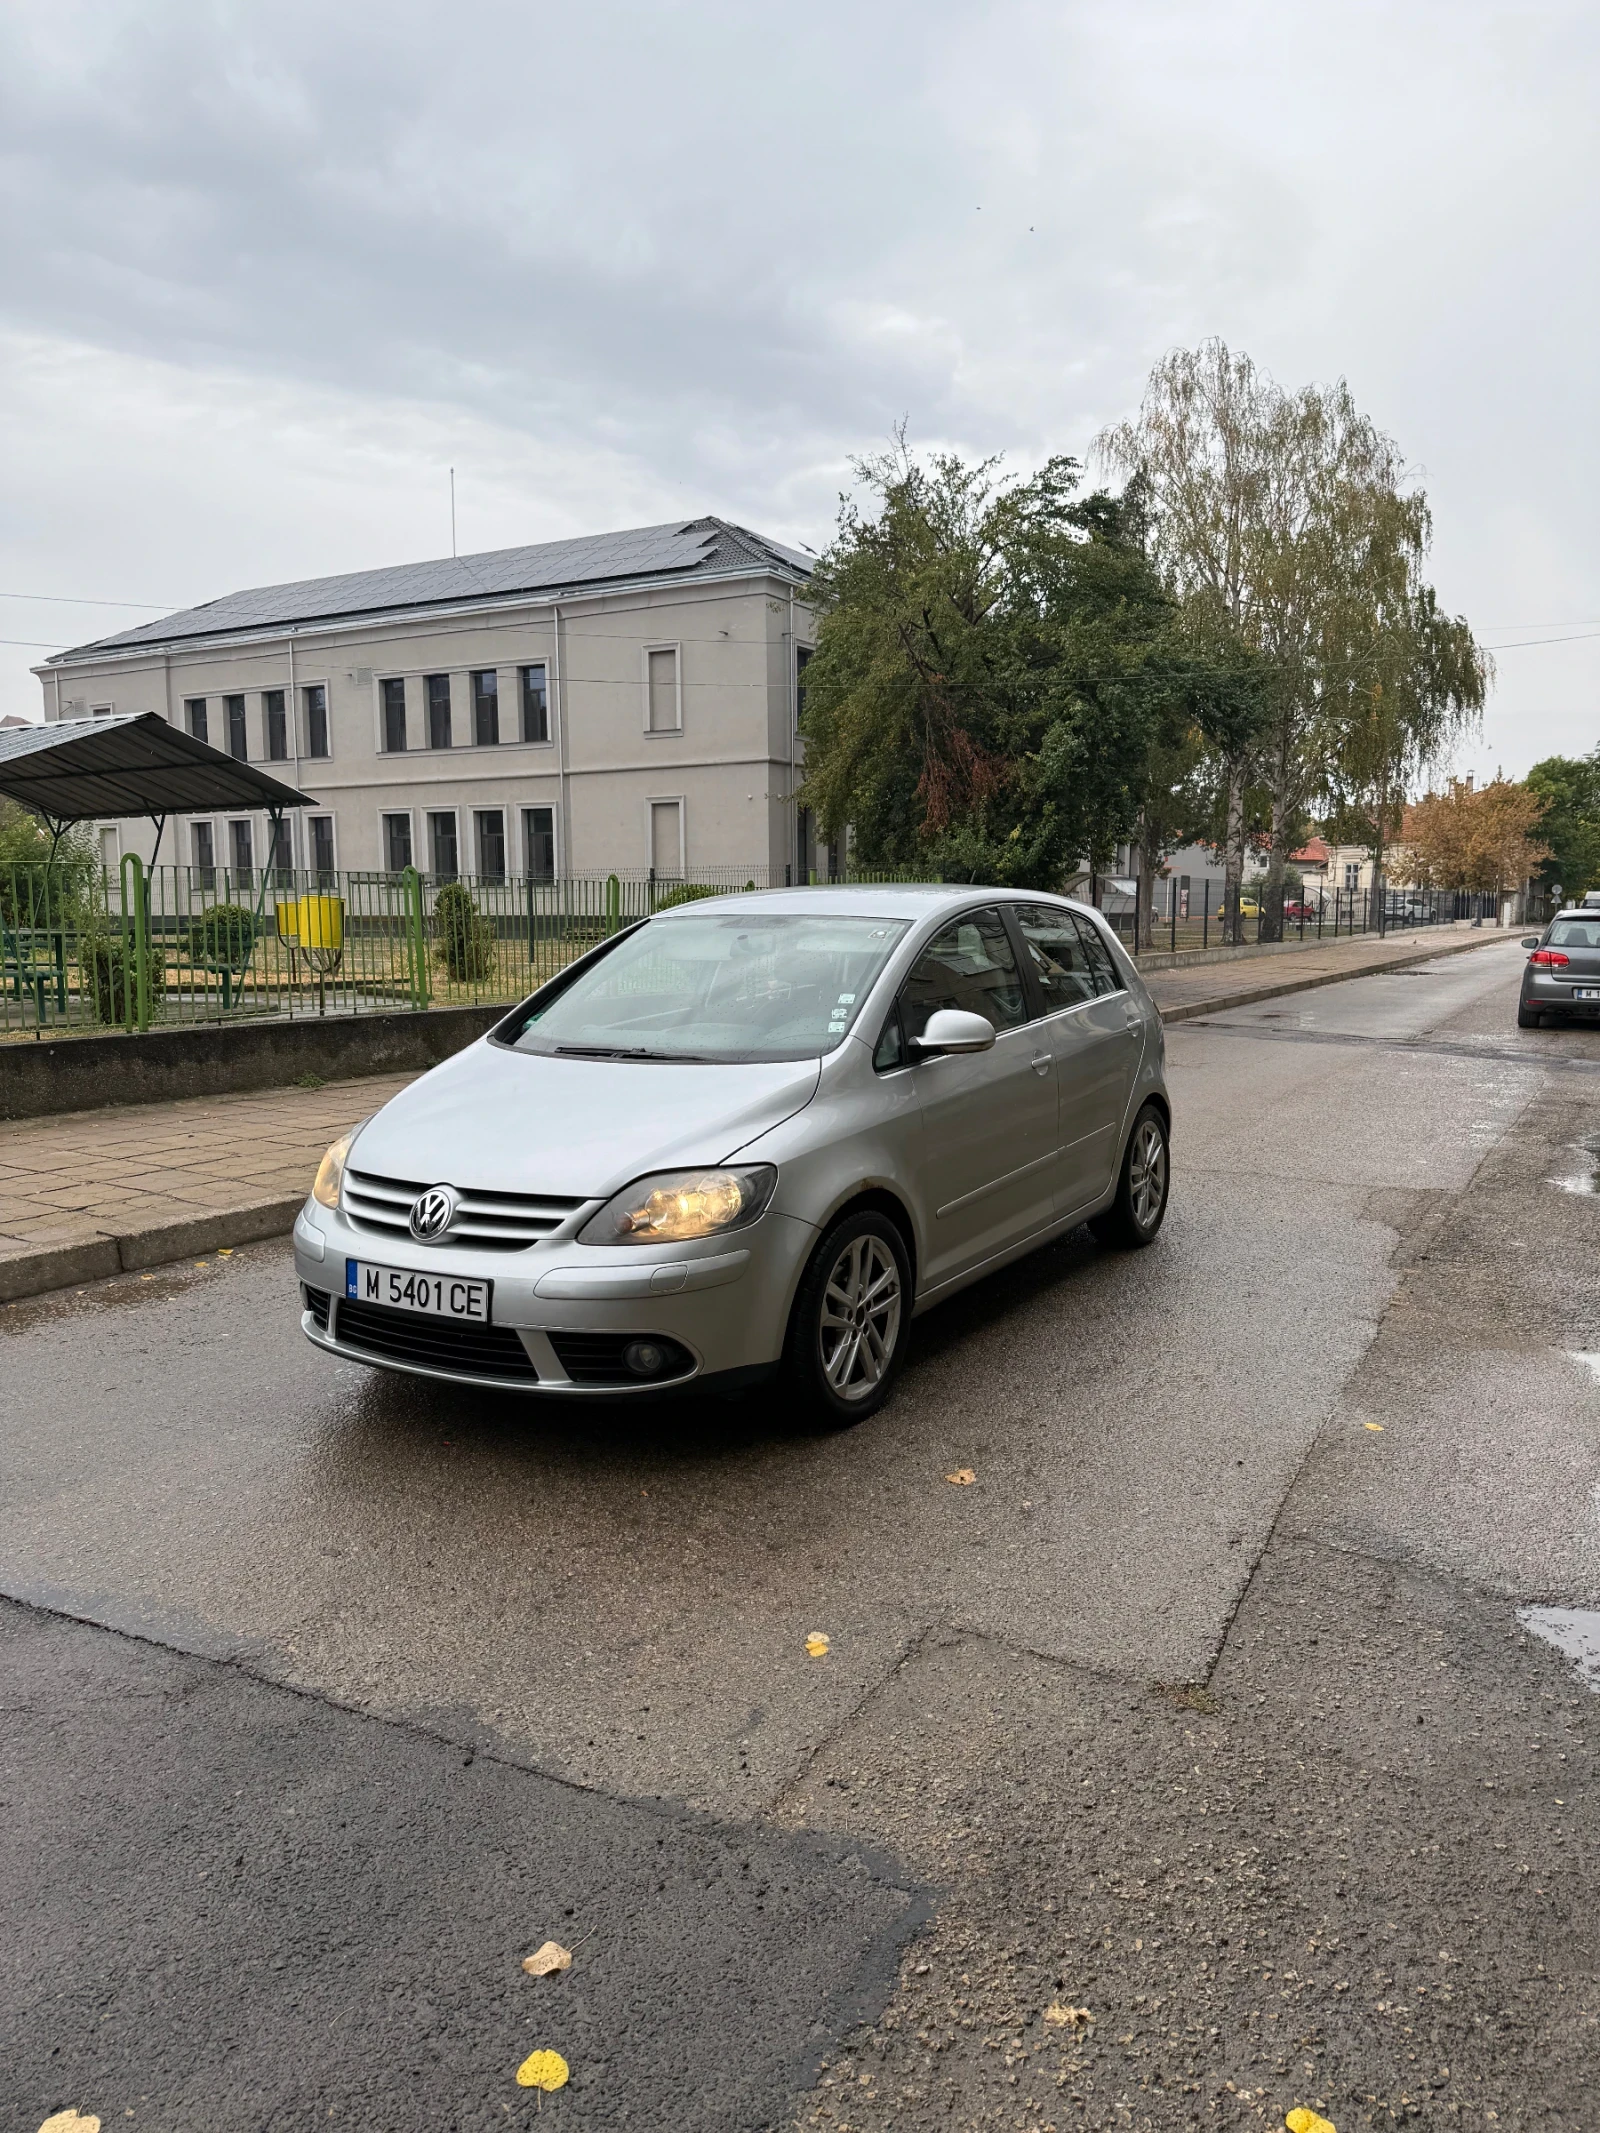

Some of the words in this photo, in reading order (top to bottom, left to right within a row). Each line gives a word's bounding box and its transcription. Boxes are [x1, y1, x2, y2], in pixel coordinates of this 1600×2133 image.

[411, 1191, 451, 1239] VW
[348, 1284, 357, 1294] BG
[366, 1269, 380, 1300] M
[389, 1273, 442, 1311] 5401
[450, 1283, 483, 1317] CE
